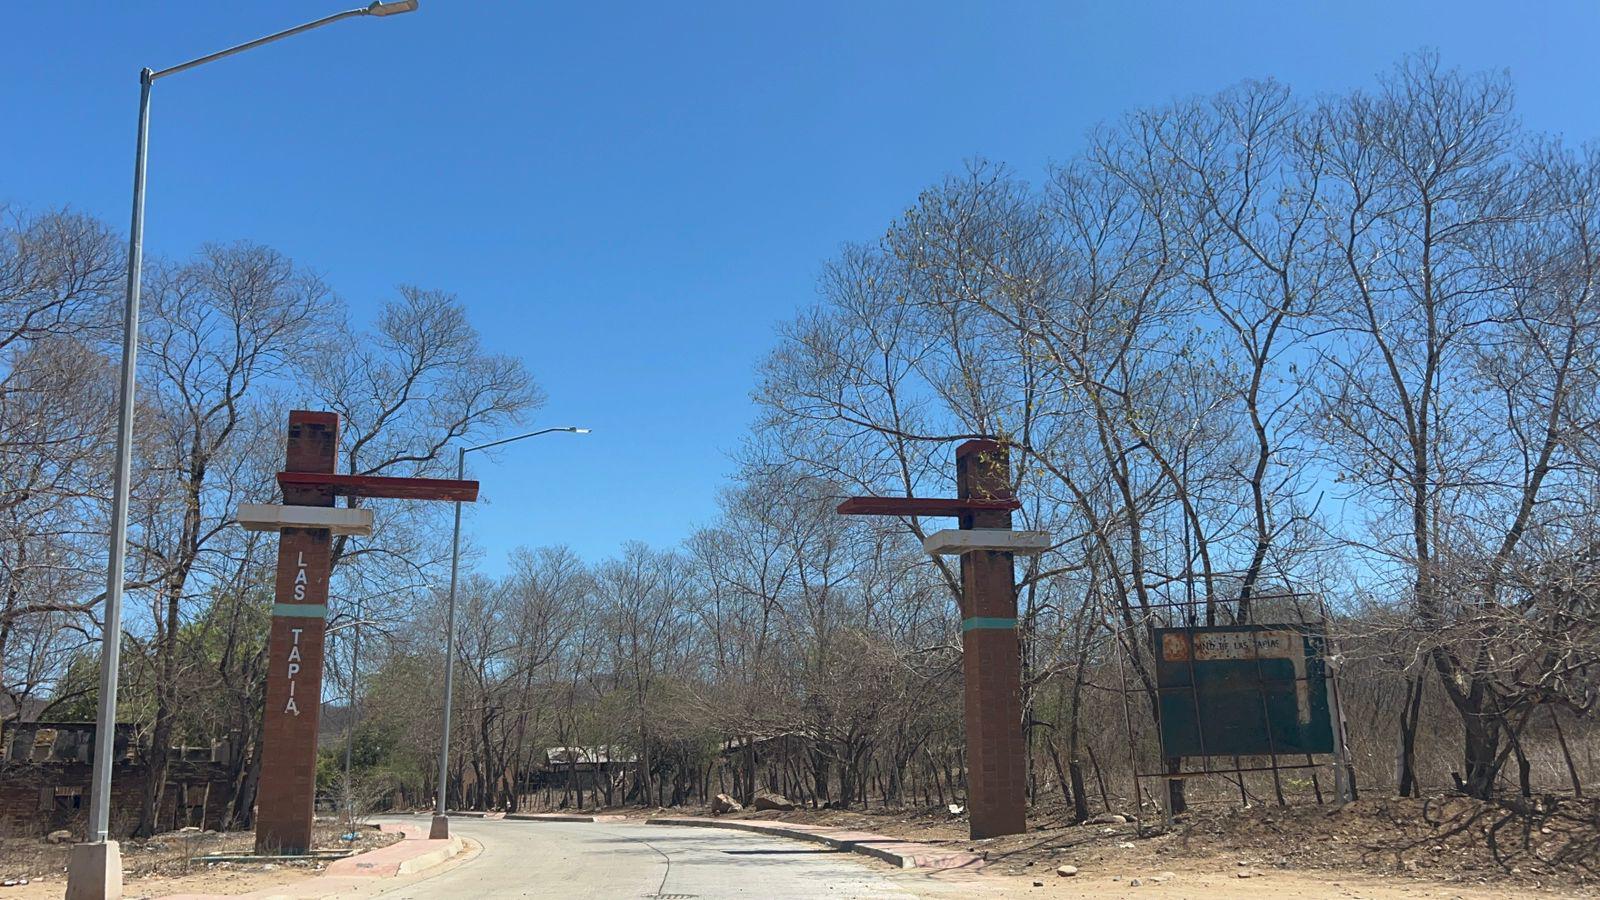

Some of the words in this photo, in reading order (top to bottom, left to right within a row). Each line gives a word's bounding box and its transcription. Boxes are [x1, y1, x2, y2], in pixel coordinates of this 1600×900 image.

[294, 552, 308, 600] LAS
[1234, 640, 1249, 650] LAS
[284, 629, 303, 716] TAPIA
